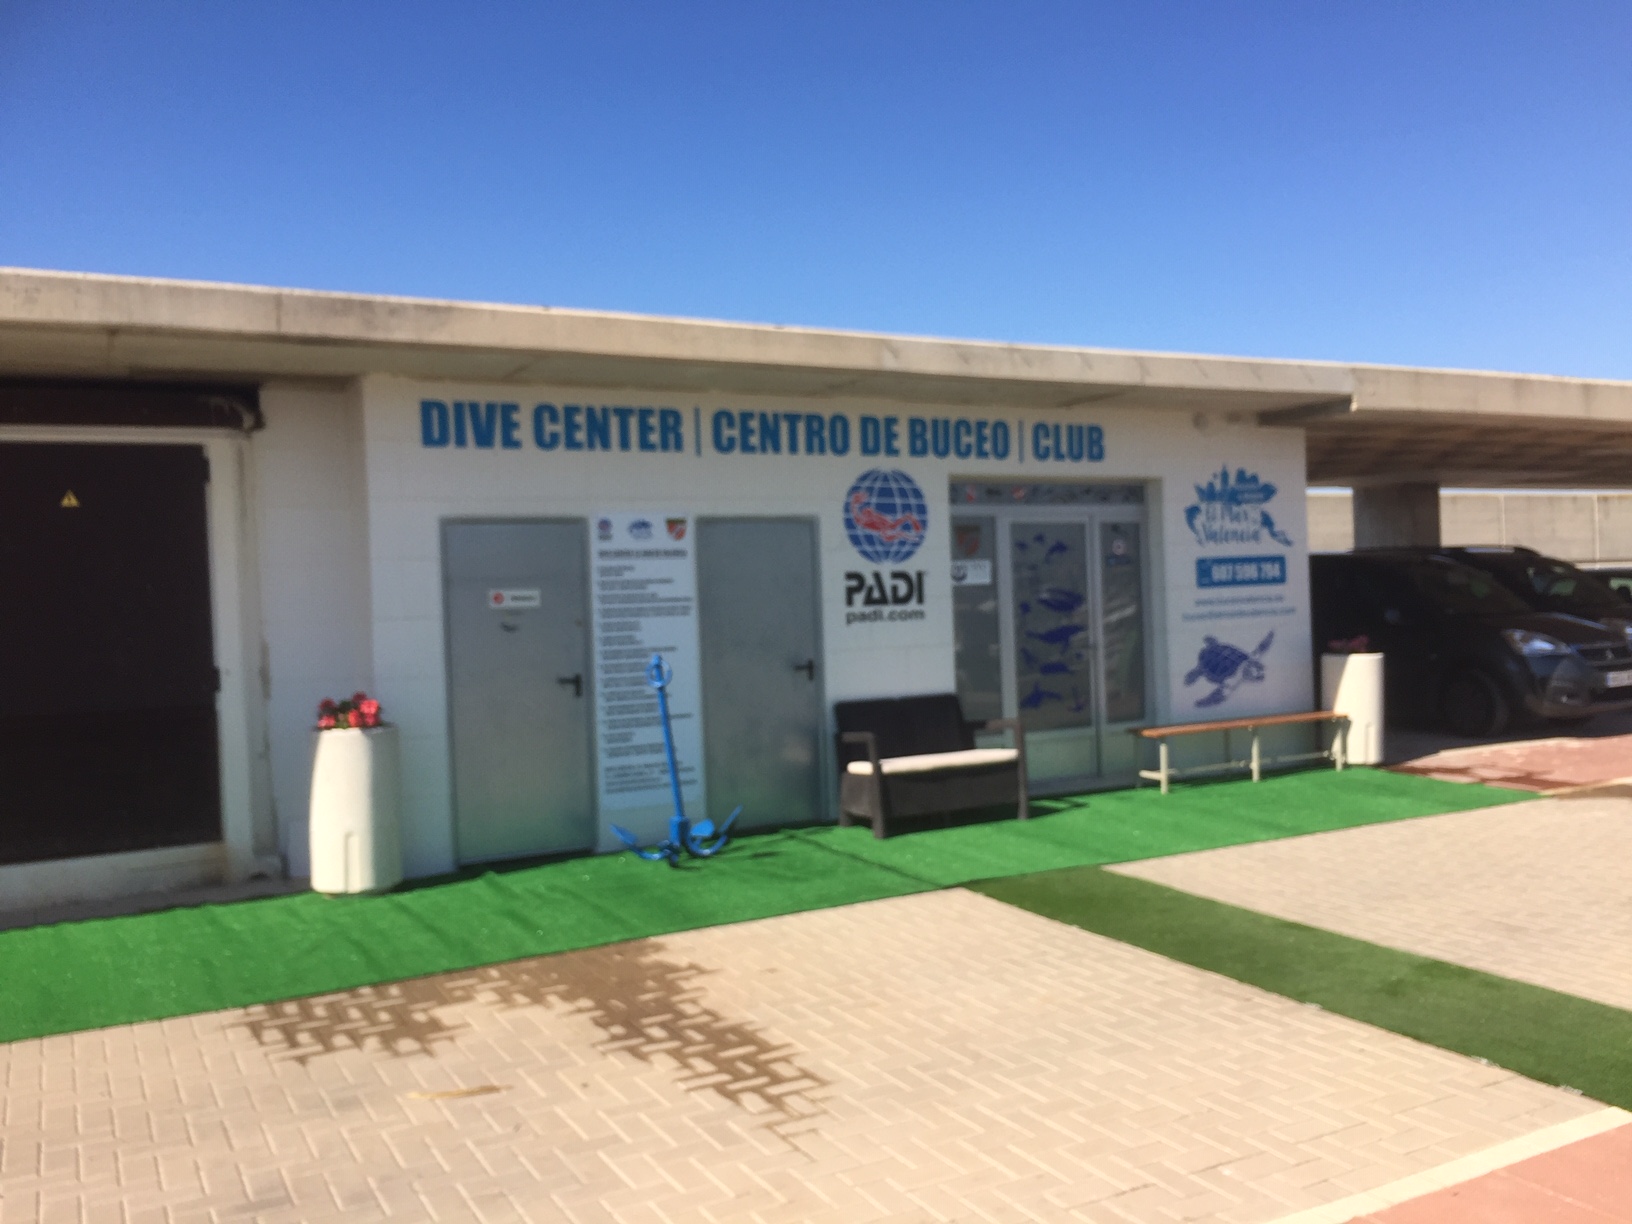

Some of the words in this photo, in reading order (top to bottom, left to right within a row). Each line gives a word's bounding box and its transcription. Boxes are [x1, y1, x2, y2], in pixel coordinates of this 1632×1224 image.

[420, 399, 522, 449] DIVE
[532, 402, 684, 453] CENTER
[712, 410, 850, 456] CENTRO
[860, 415, 899, 457] DE
[908, 418, 1010, 461] BUCEO
[1032, 421, 1106, 462] CLUB
[845, 570, 925, 607] PADI
[845, 609, 926, 625] padi.com
